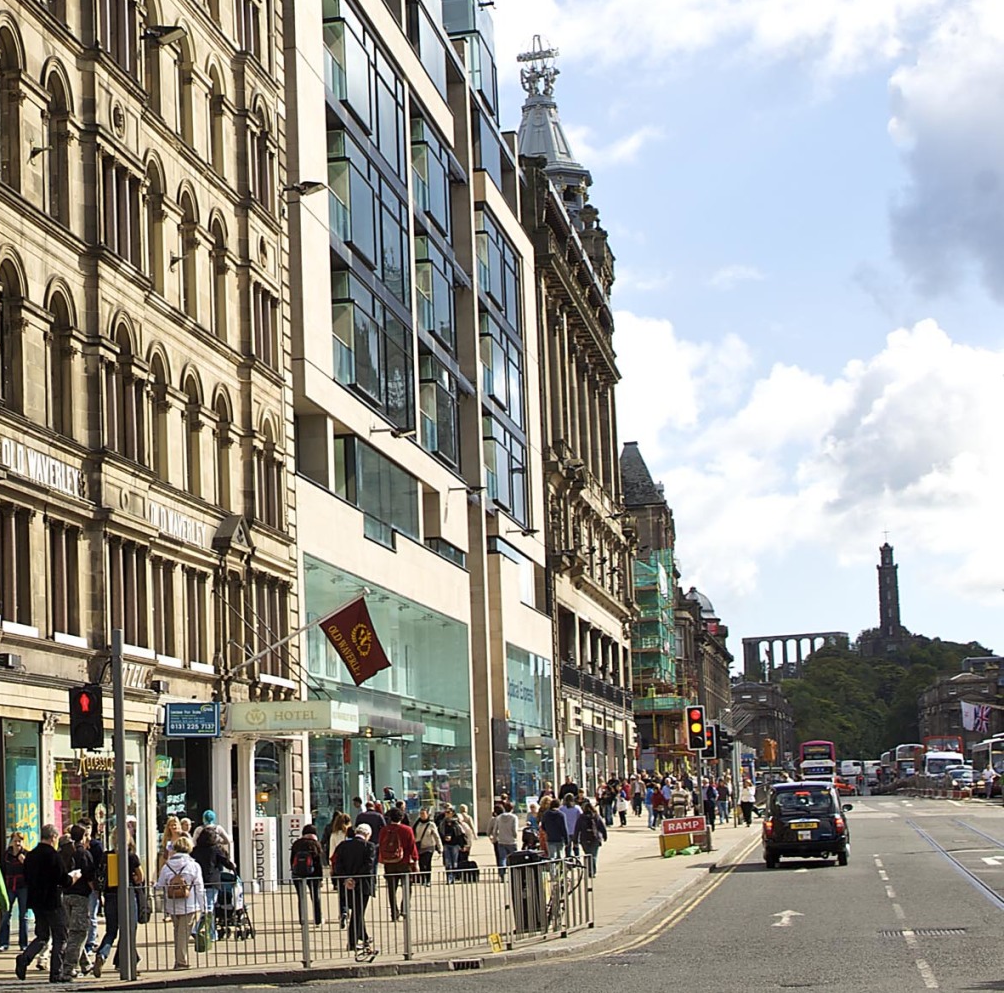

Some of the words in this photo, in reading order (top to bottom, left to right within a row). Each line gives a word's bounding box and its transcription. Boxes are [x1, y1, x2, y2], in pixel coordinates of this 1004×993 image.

[2, 437, 25, 475] OLD
[27, 448, 79, 497] WAVERLEY
[169, 508, 206, 549] WAVERLEY
[327, 624, 343, 642] OLD
[274, 710, 318, 721] HOTEL
[668, 821, 700, 831] RAMP
[253, 833, 265, 885] swatch
